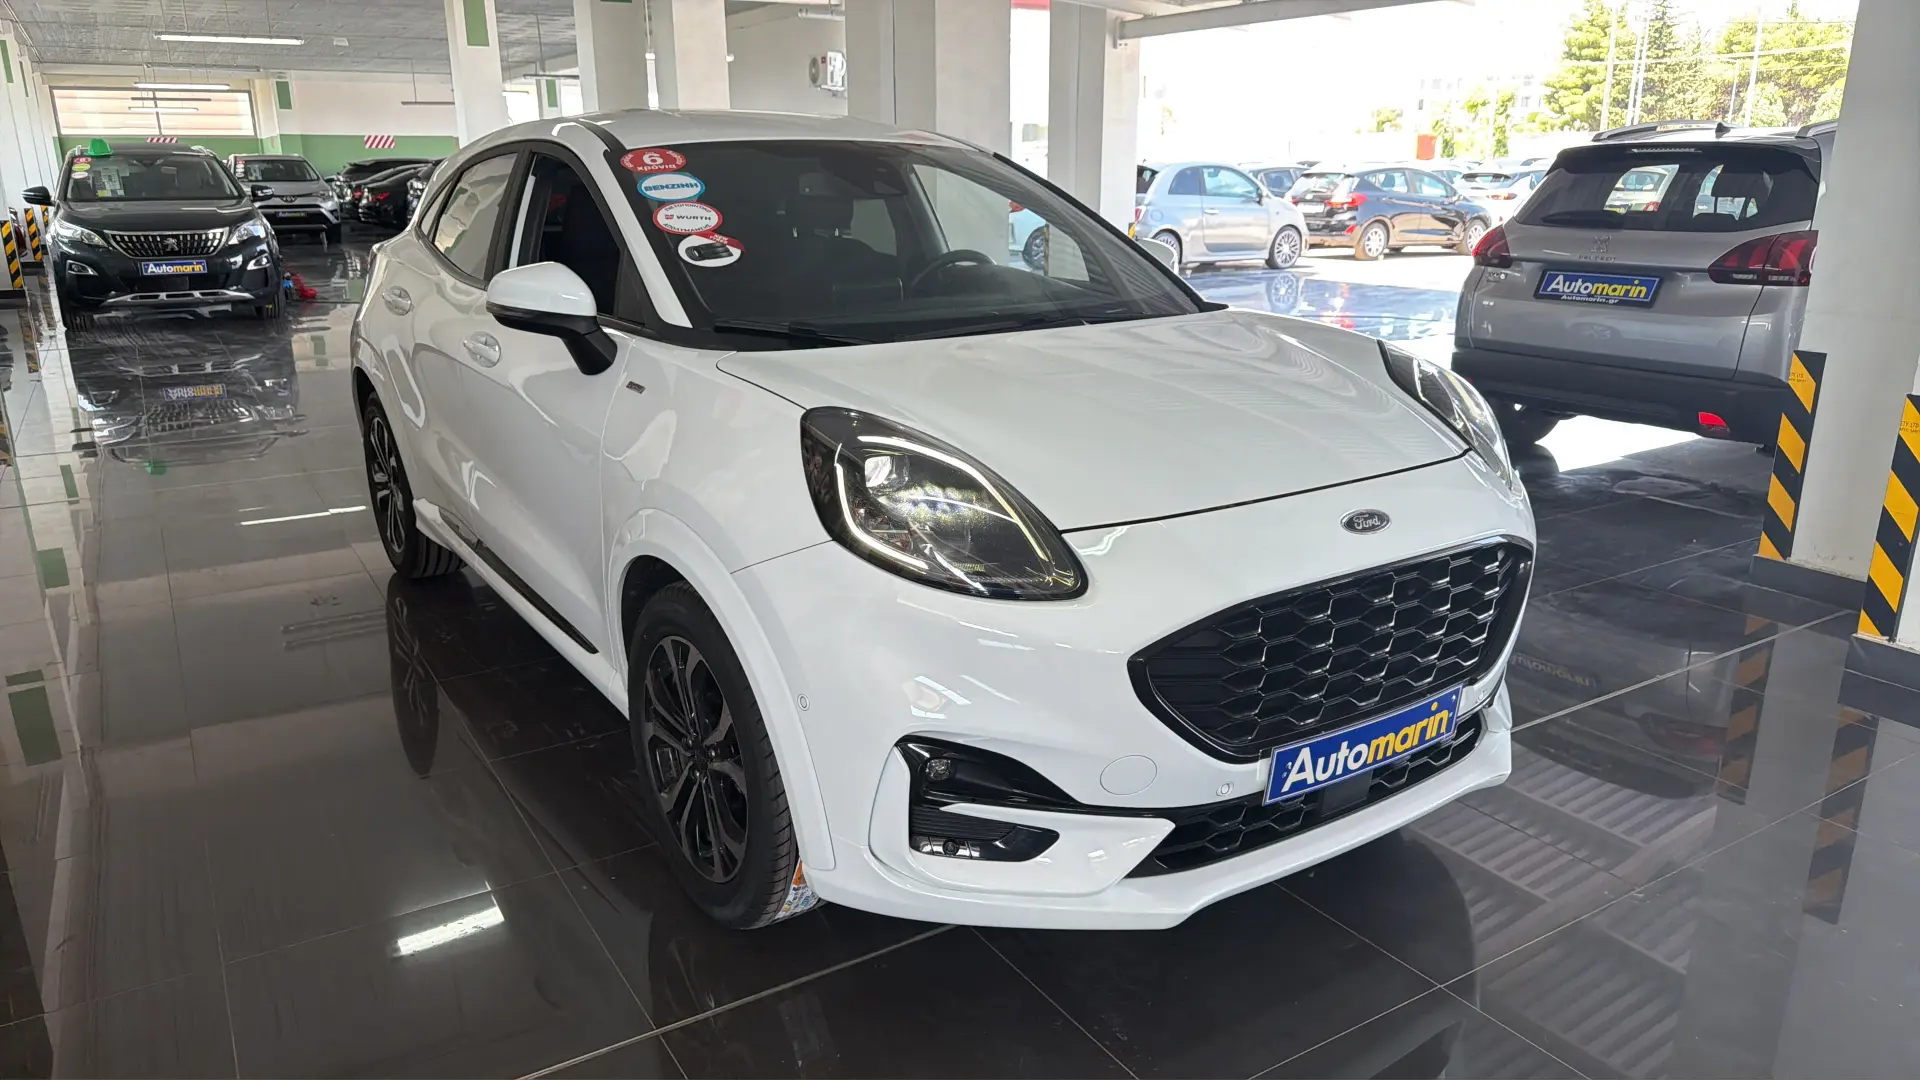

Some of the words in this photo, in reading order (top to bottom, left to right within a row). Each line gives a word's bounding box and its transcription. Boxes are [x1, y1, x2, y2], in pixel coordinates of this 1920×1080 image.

[642, 153, 664, 165] 6
[147, 260, 204, 274] Automarin
[1546, 274, 1648, 298] Automarin
[1560, 294, 1620, 304] Automarin.gr
[1353, 513, 1381, 530] Ford
[1280, 702, 1449, 793] Automarin
